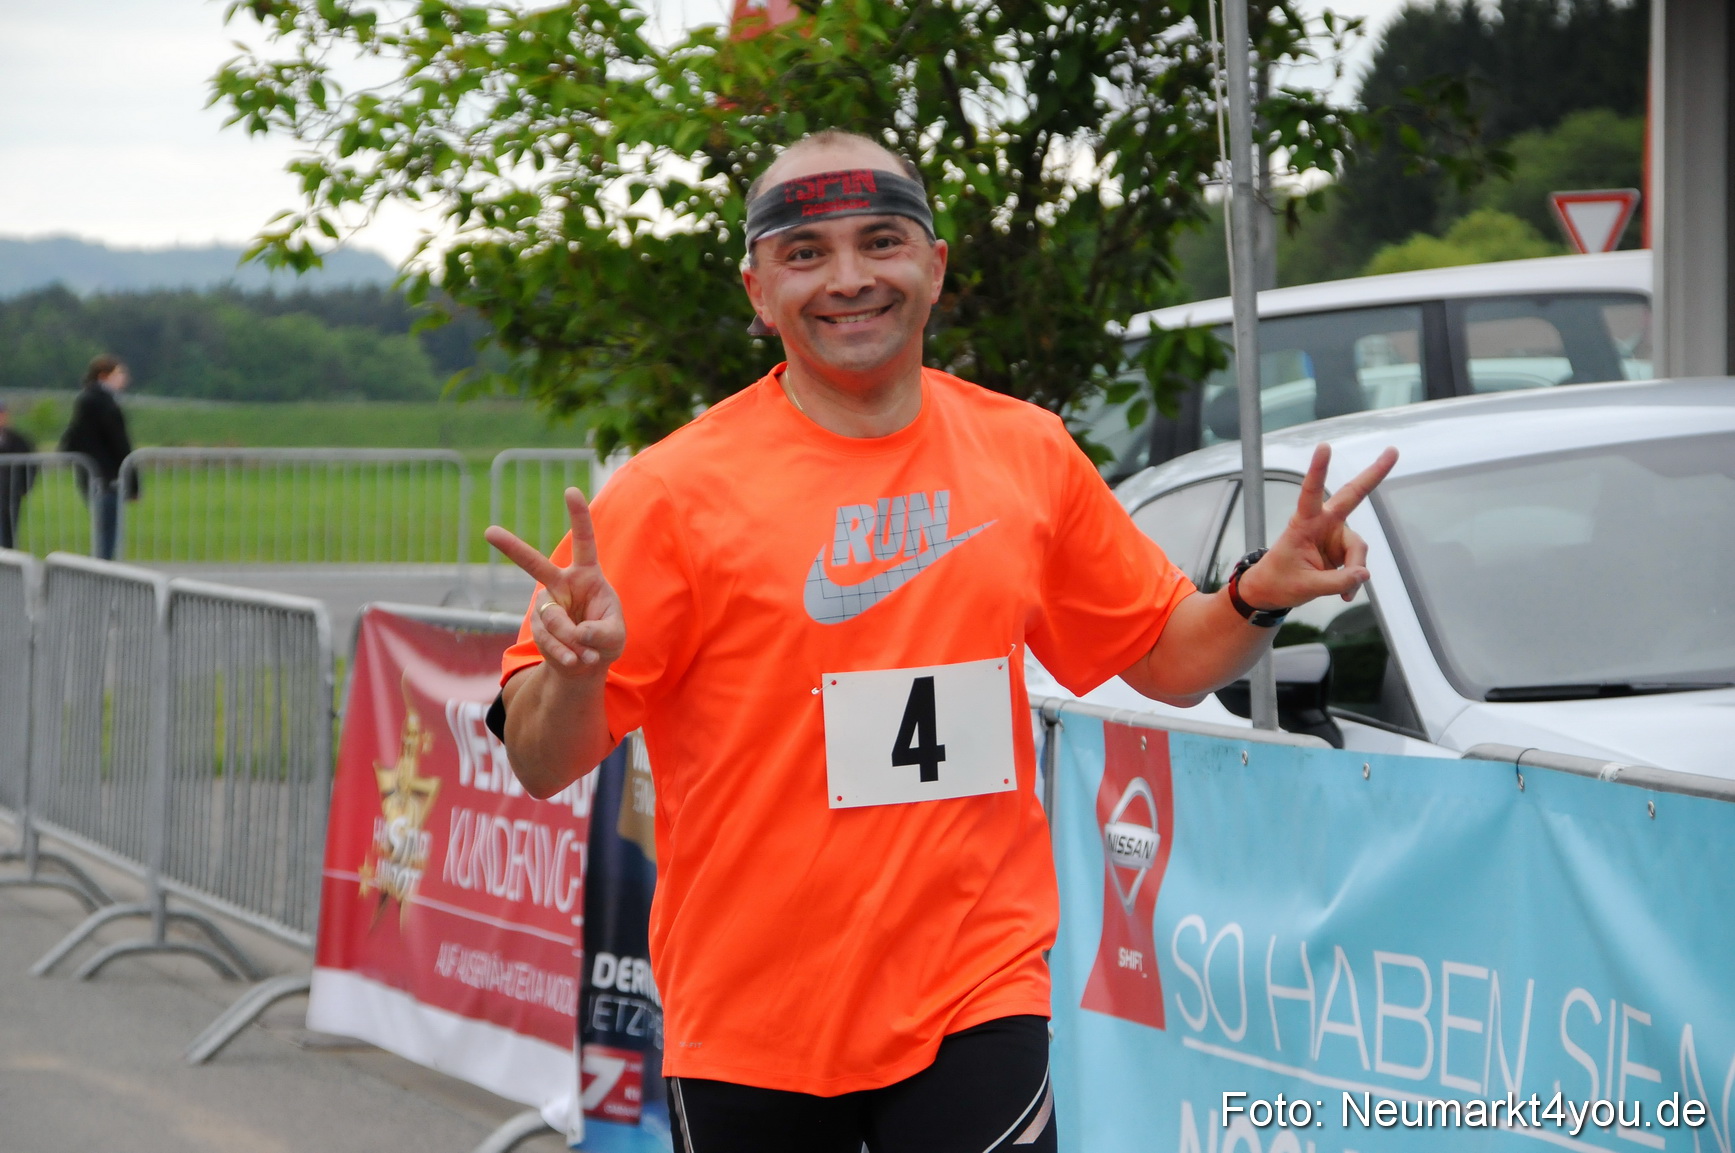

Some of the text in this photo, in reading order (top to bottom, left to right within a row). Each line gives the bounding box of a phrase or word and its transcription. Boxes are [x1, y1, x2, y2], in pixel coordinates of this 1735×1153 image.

[831, 490, 950, 567] RUN
[891, 675, 946, 782] 4
[1107, 833, 1154, 860] NISSAN
[1172, 914, 1247, 1043] SO
[1266, 934, 1535, 1104] HABEN
[1553, 988, 1666, 1150] SIE
